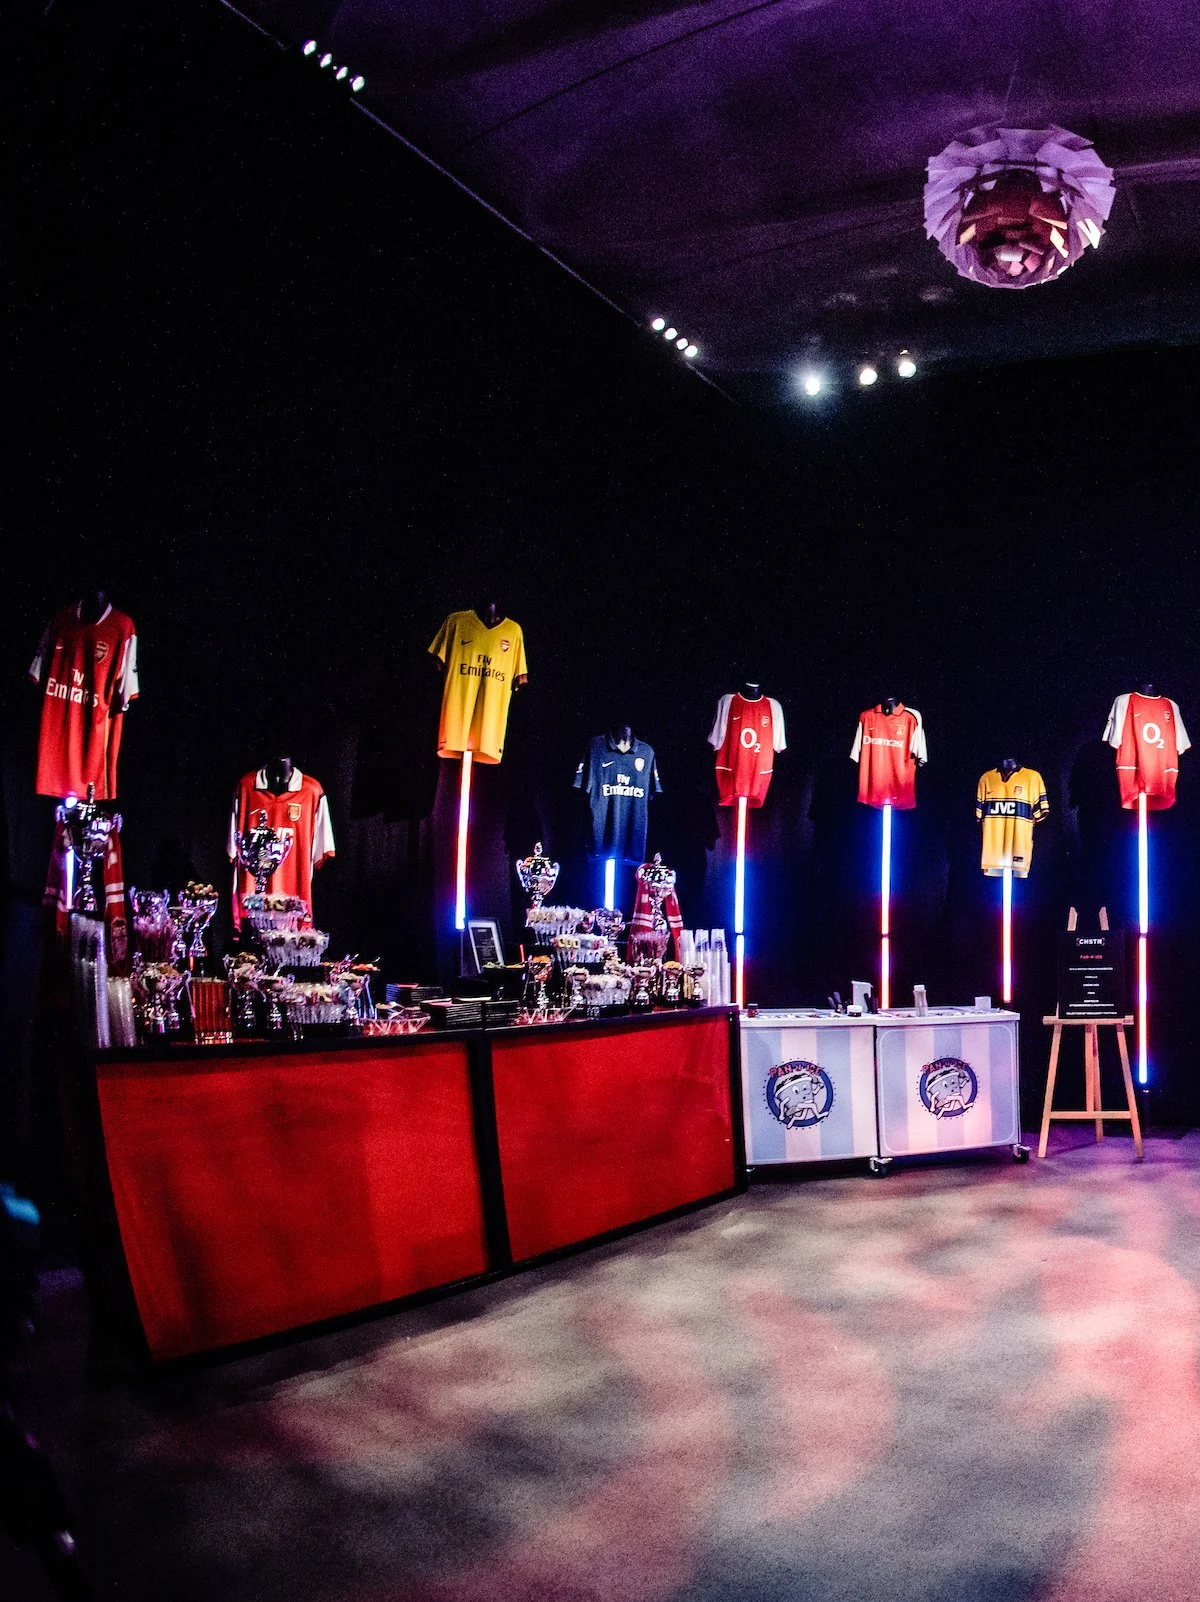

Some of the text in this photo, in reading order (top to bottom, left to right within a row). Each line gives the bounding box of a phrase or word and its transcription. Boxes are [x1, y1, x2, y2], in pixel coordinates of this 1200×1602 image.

[477, 654, 492, 666] Fly
[460, 663, 505, 682] Emirates
[863, 735, 904, 748] Dreamcast
[616, 773, 631, 785] Fly
[602, 784, 645, 798] Emirates
[990, 802, 1016, 815] JVC
